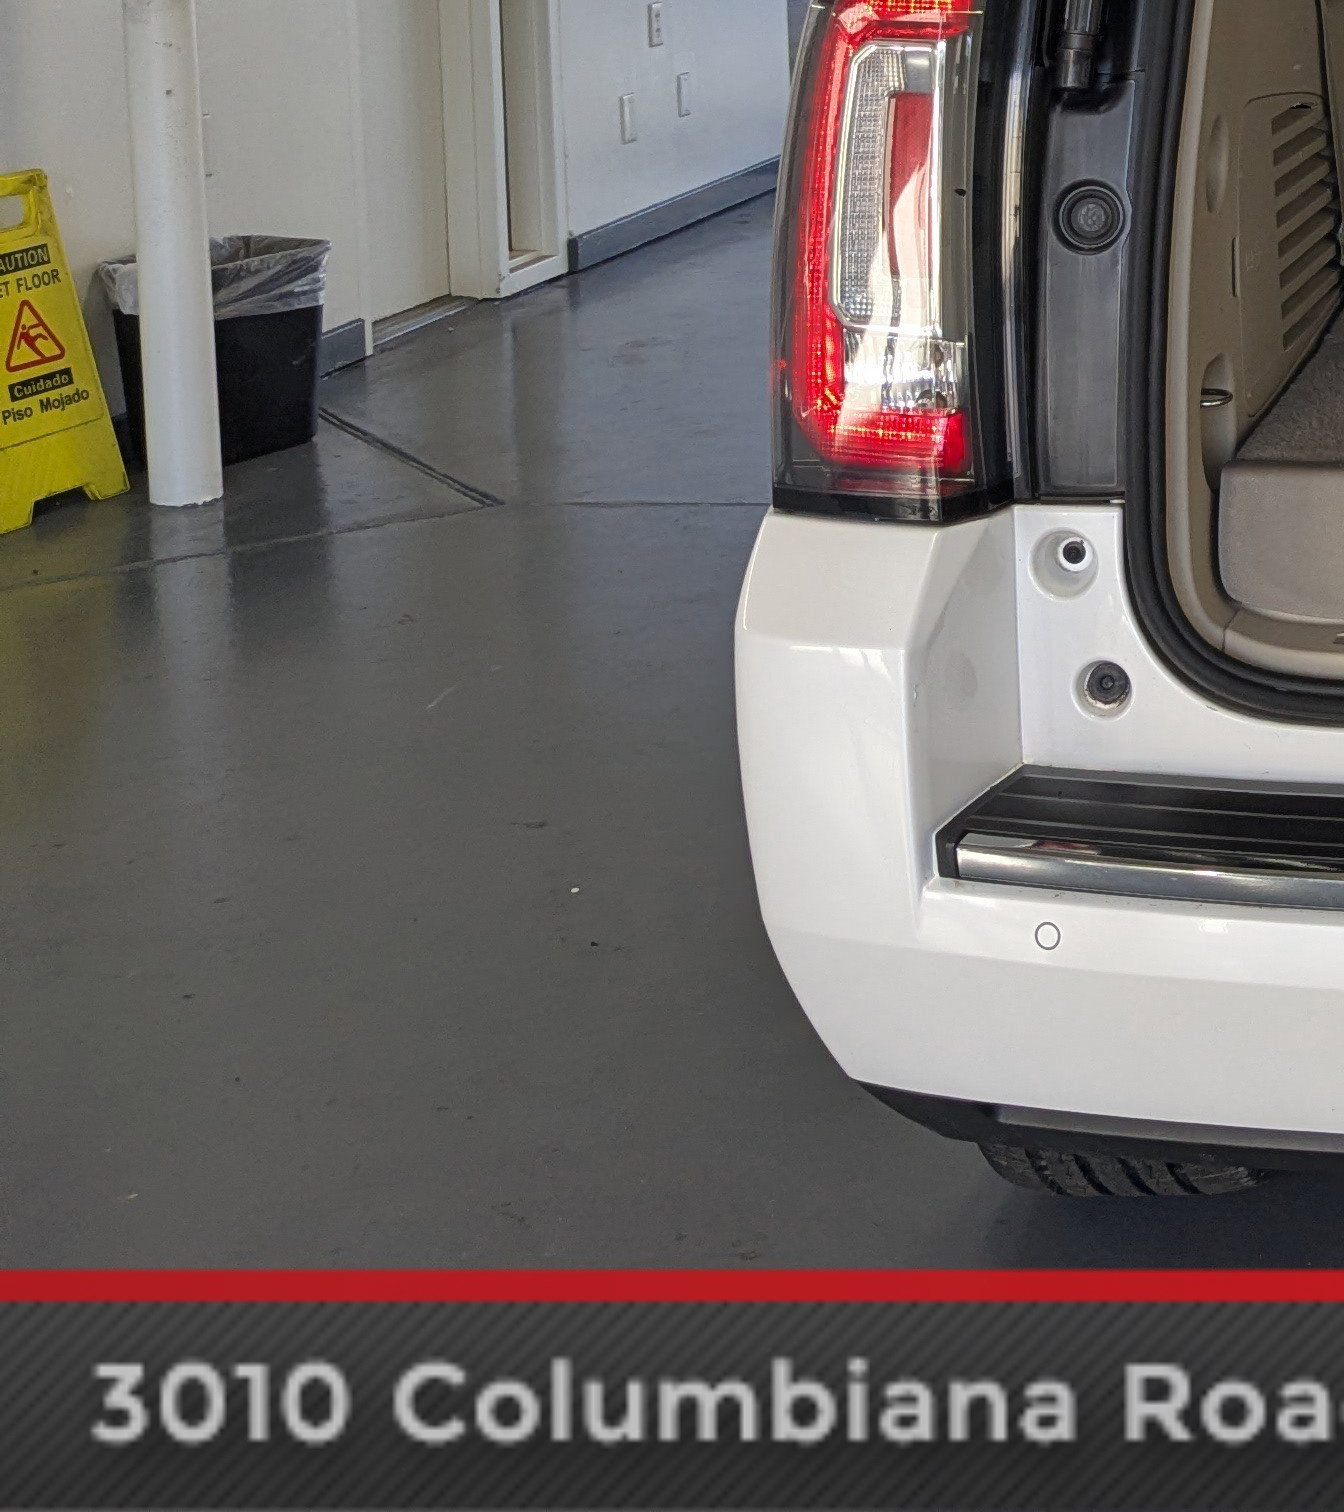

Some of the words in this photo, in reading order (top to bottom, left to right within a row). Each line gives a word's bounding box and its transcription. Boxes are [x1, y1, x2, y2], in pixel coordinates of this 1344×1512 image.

[0, 246, 49, 273] AUTION
[15, 268, 62, 294] FLOOR
[13, 373, 70, 398] Cuidado
[1, 406, 34, 426] Piso
[39, 388, 90, 414] Mojado
